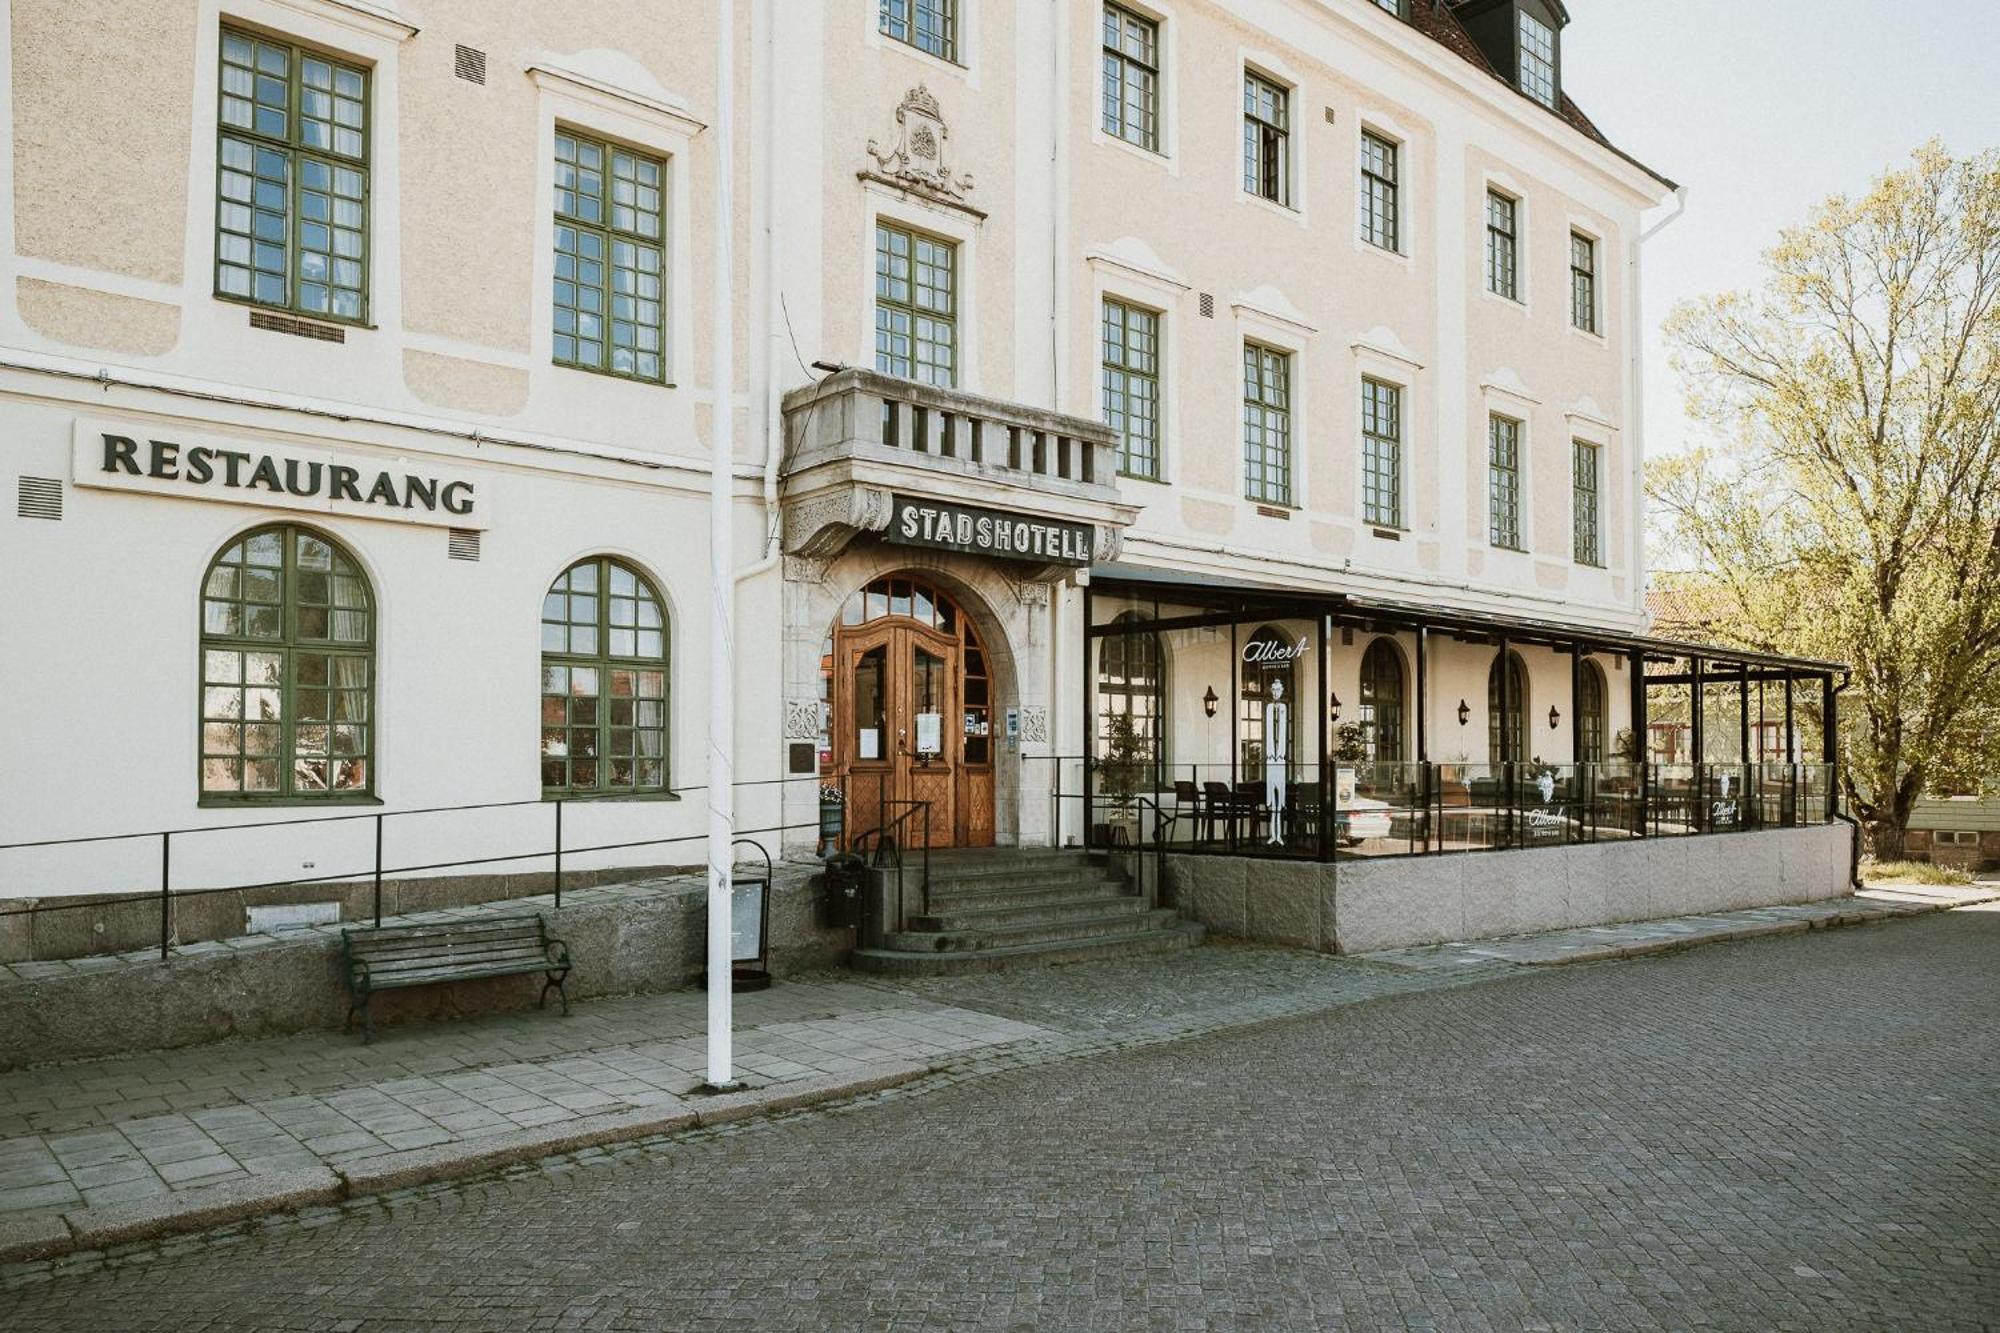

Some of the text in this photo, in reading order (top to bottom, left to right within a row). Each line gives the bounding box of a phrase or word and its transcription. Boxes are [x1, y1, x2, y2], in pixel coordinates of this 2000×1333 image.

[101, 433, 474, 514] RESTAURANG
[901, 505, 1089, 561] STADSHOTELL
[1242, 636, 1311, 662] Albert
